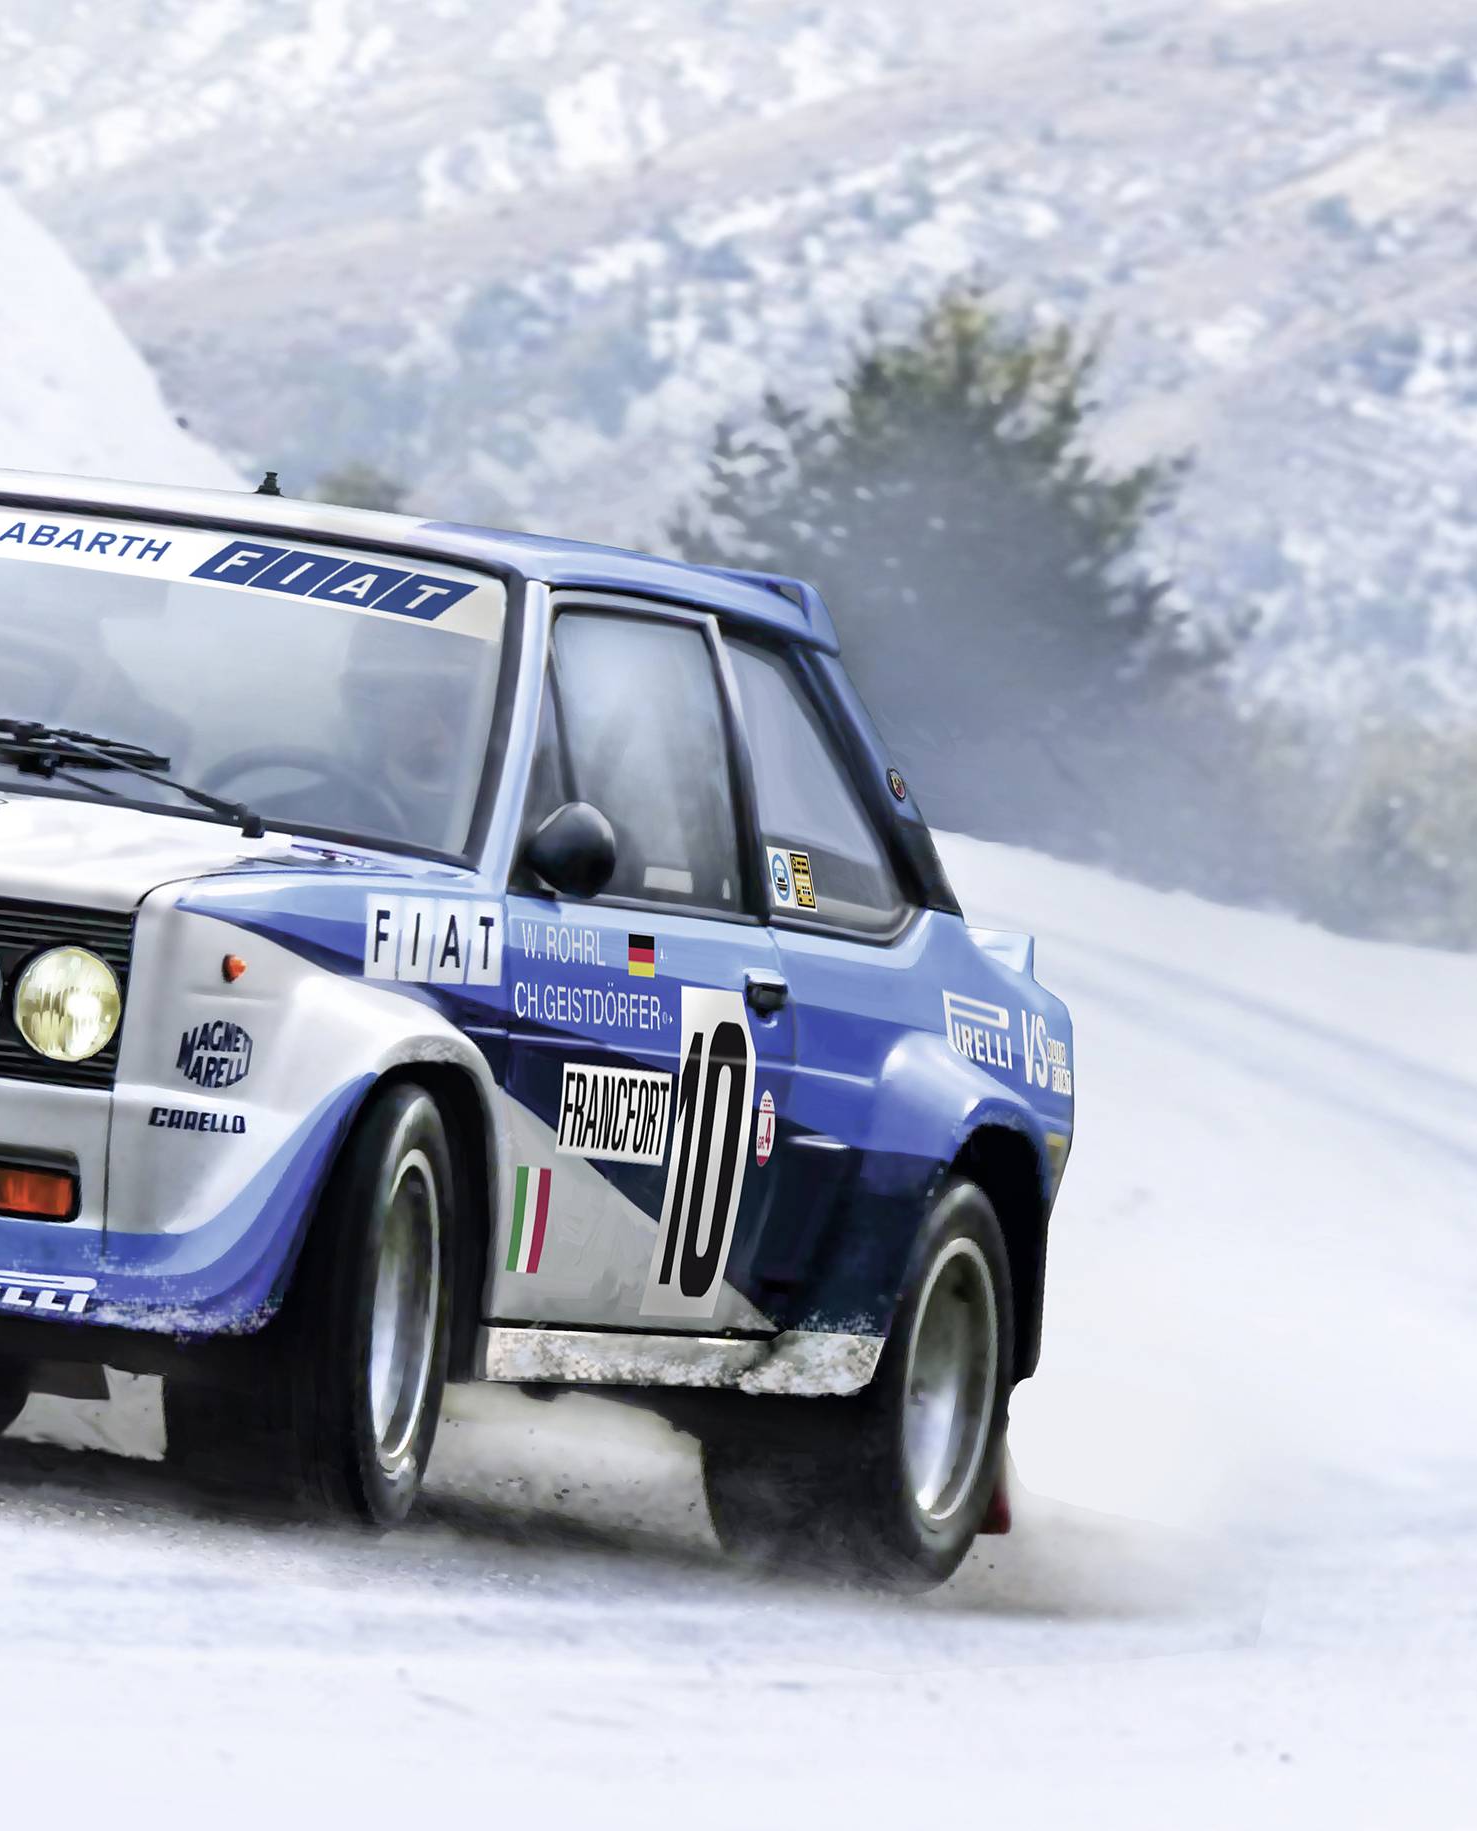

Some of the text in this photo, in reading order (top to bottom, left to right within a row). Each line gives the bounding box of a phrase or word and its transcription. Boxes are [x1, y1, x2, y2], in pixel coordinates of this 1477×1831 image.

[215, 547, 455, 610] FIAT
[374, 909, 497, 972] FIAT
[522, 922, 541, 960] W.
[514, 978, 661, 1031] CH.GEISTDÖRFER
[943, 989, 1048, 1089] PIRELLI VS
[148, 1106, 246, 1134] CARELLO
[558, 1070, 672, 1157] FRANCFORT
[765, 1117, 772, 1151] 4
[658, 1021, 747, 1298] 10
